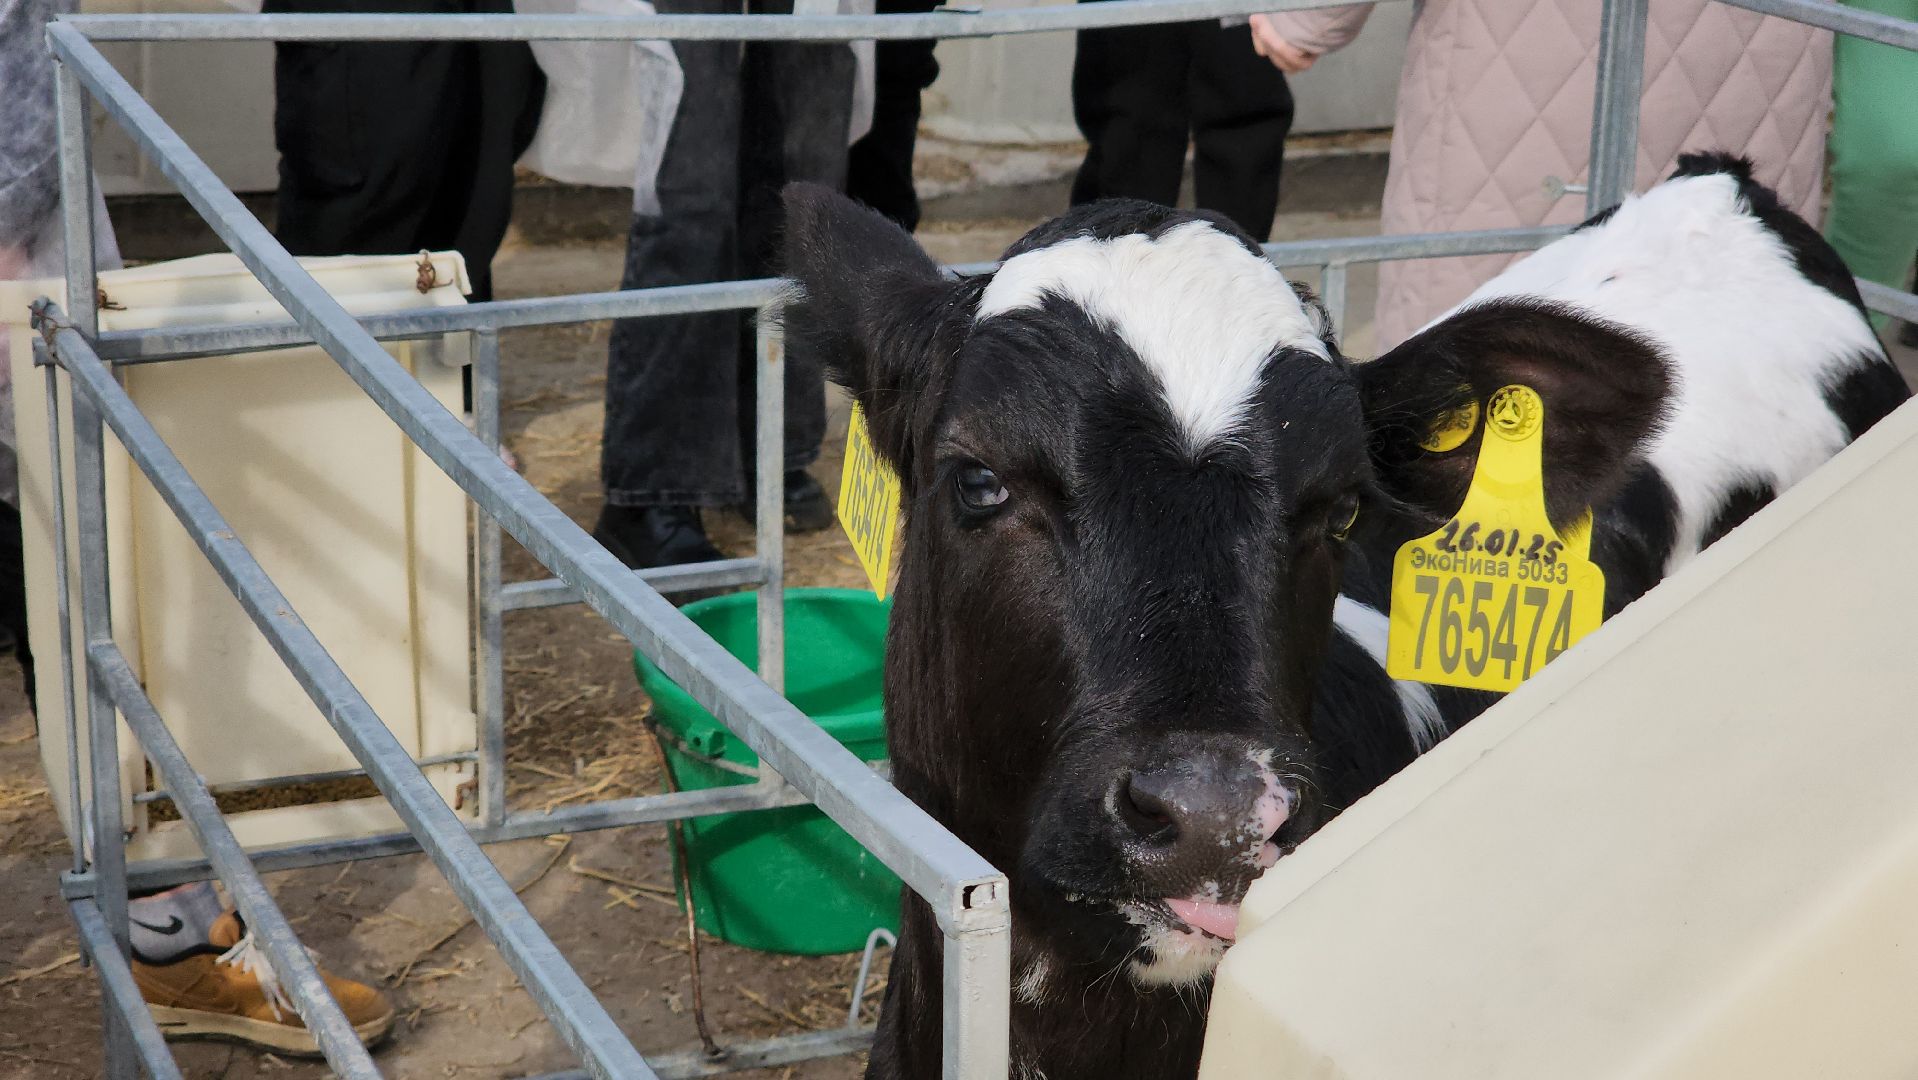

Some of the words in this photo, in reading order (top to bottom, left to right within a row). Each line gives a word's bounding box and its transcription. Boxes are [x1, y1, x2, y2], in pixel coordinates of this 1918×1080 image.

[844, 432, 891, 579] 765474
[1435, 519, 1564, 565] 26.01.25
[1411, 546, 1509, 578] ЭкоНива
[1517, 558, 1569, 585] 5033
[1414, 574, 1574, 682] 765474
